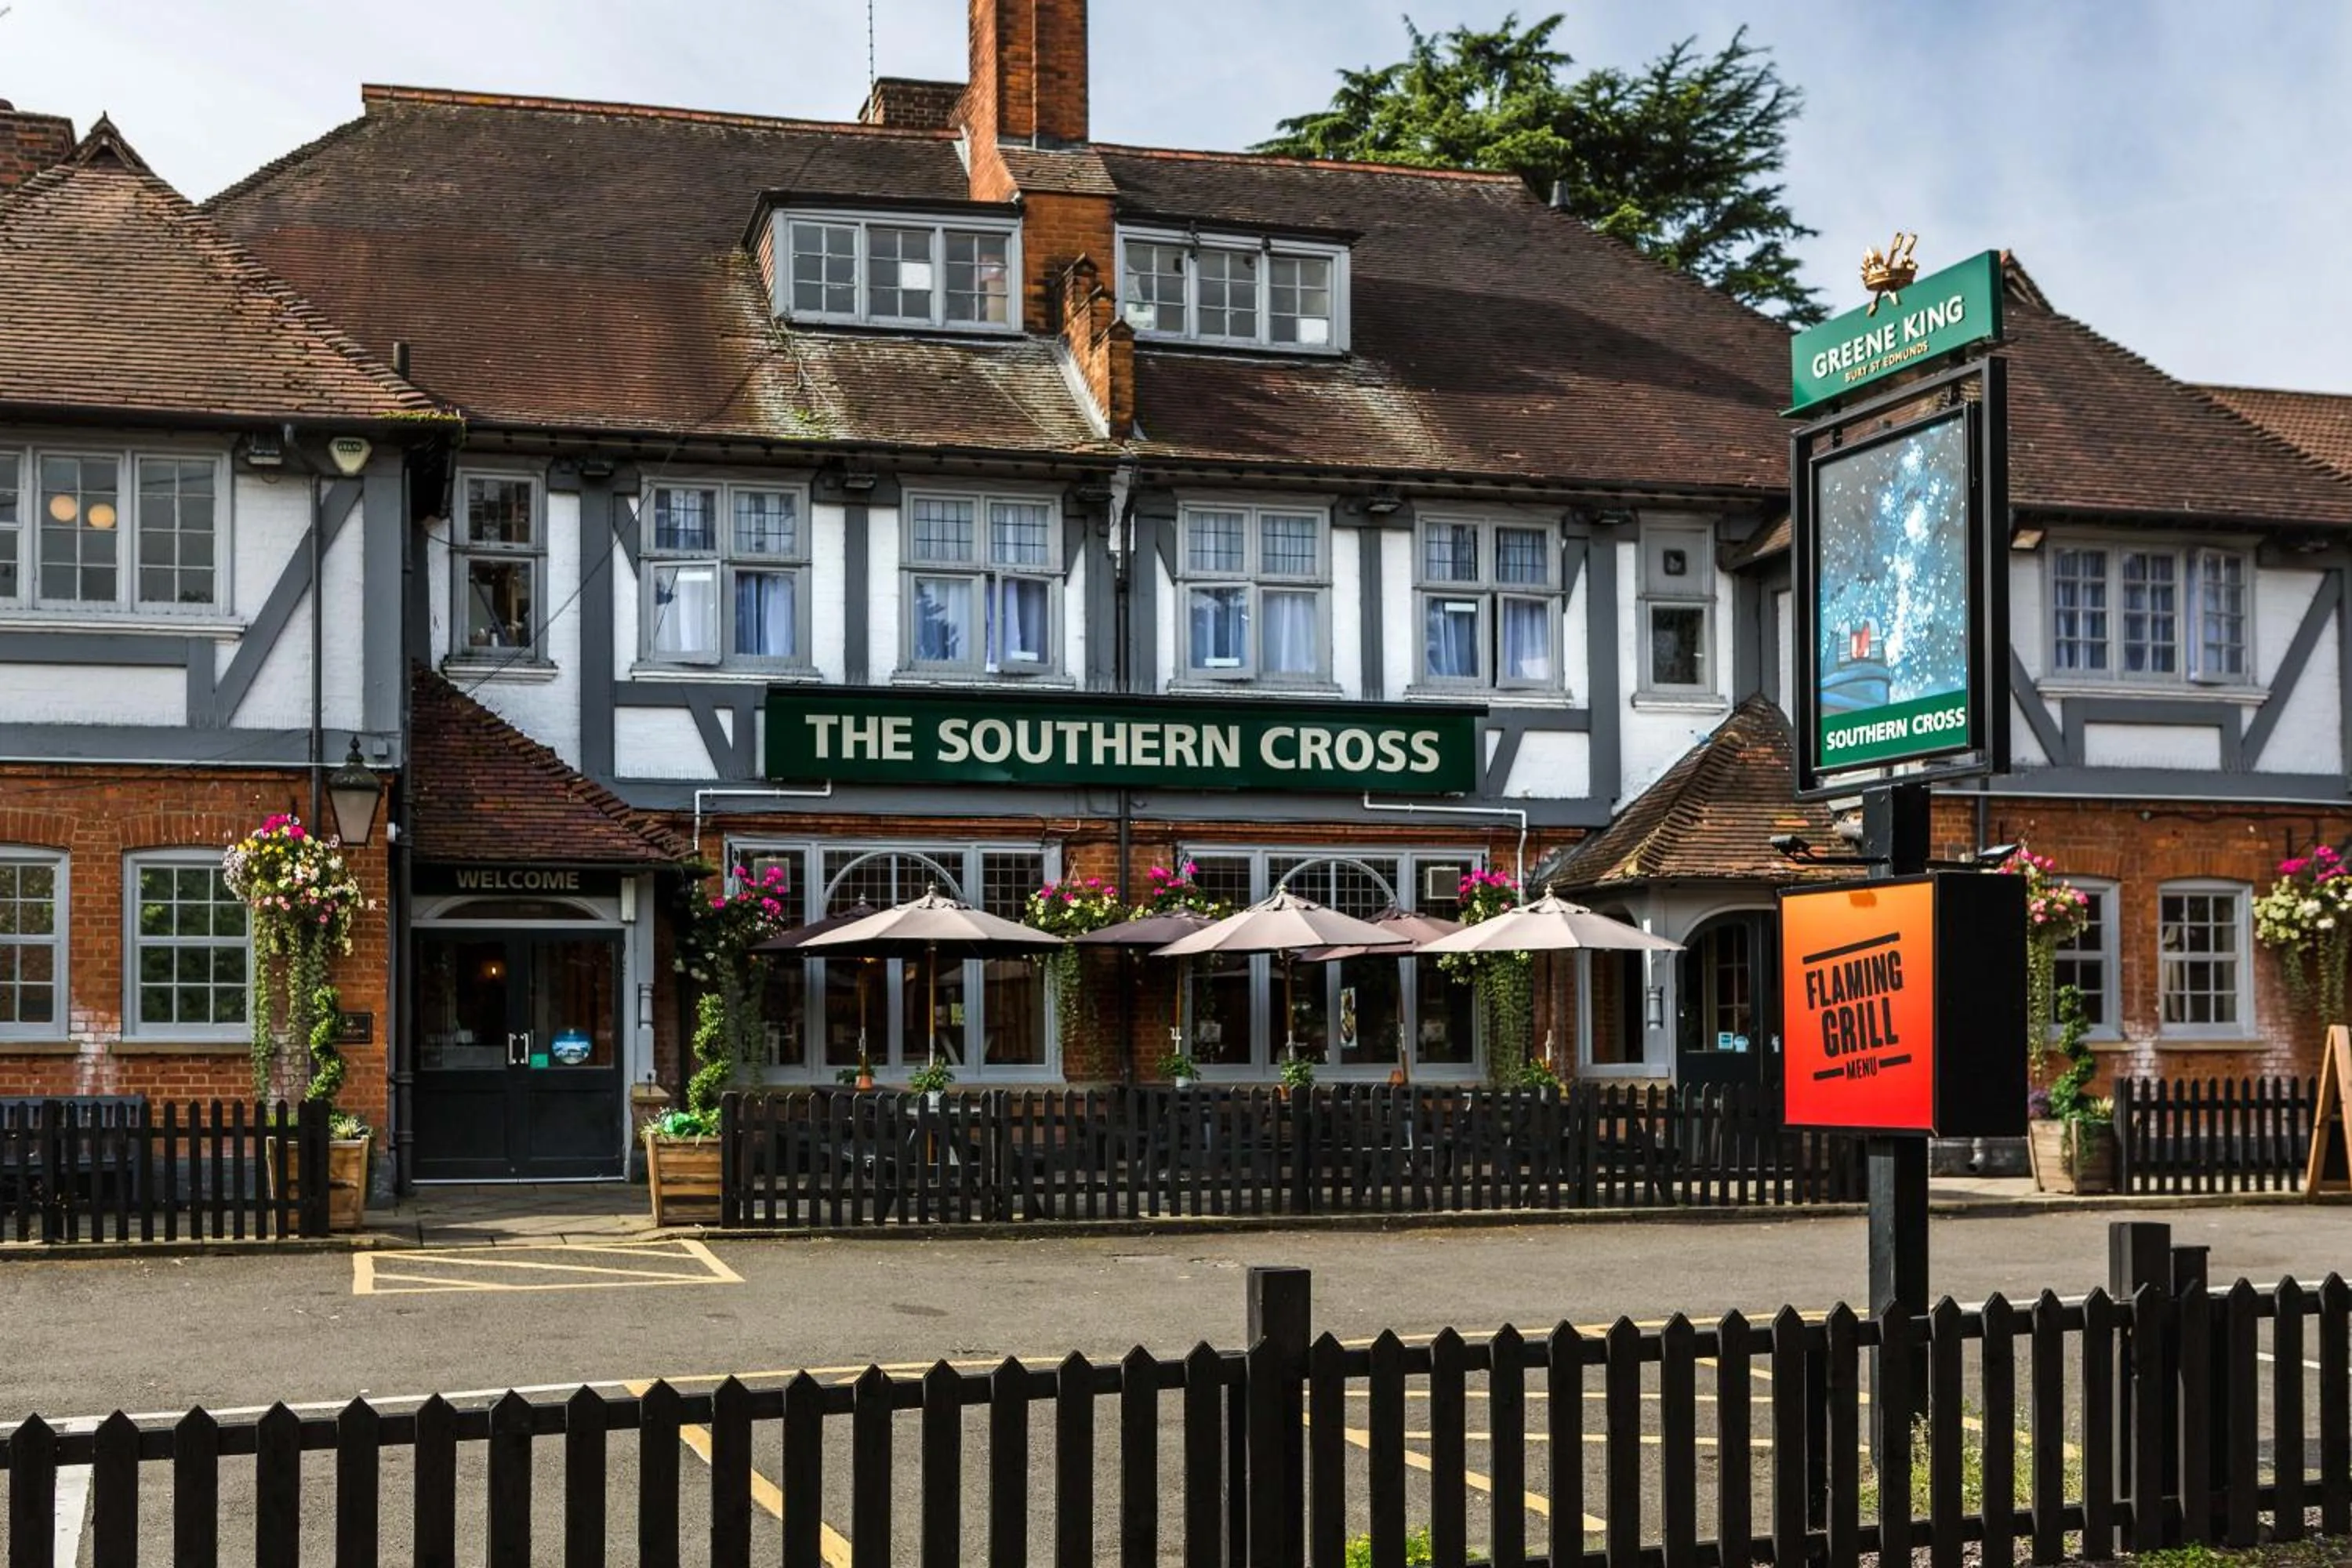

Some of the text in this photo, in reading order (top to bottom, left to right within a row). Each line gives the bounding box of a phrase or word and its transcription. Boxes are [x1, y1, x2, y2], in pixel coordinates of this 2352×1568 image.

[1812, 295, 1963, 379] GREENE KING
[1870, 358, 1882, 372] ST
[1882, 340, 1929, 367] EDMUNDS
[804, 713, 1442, 773] THE SOUTHERN CROSS
[1826, 706, 1965, 750] SOUTHERN CROSS
[456, 869, 580, 890] WELCOME
[1805, 949, 1904, 1010] FLAMING
[1820, 996, 1899, 1058] GRILL
[1845, 1056, 1878, 1081] MENU
